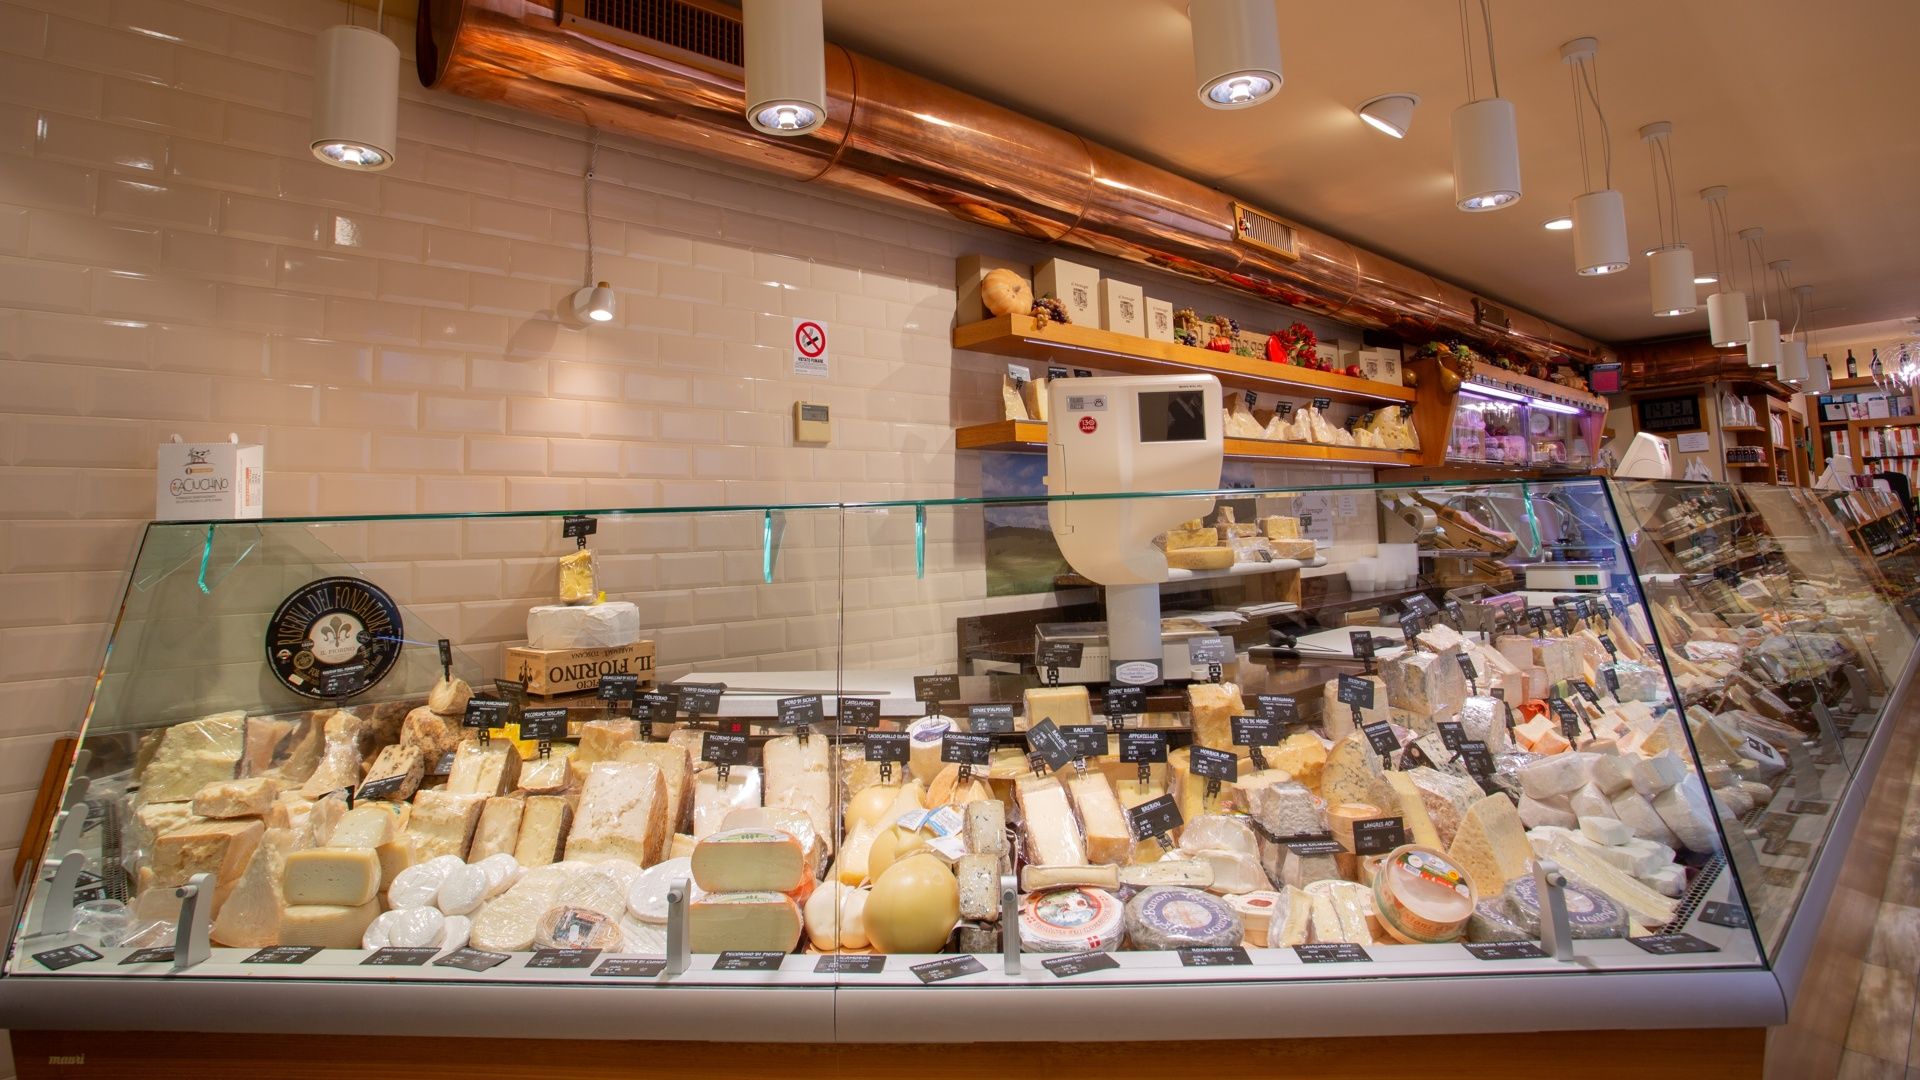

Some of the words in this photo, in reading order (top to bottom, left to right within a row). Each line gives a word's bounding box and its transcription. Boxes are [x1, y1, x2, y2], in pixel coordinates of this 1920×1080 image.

[277, 601, 314, 646] RISERVA
[306, 588, 334, 613] DEL
[335, 586, 393, 634] FONDATORE
[571, 650, 600, 659] TOSCANA
[634, 656, 652, 672] IL
[549, 658, 629, 683] FIORINO
